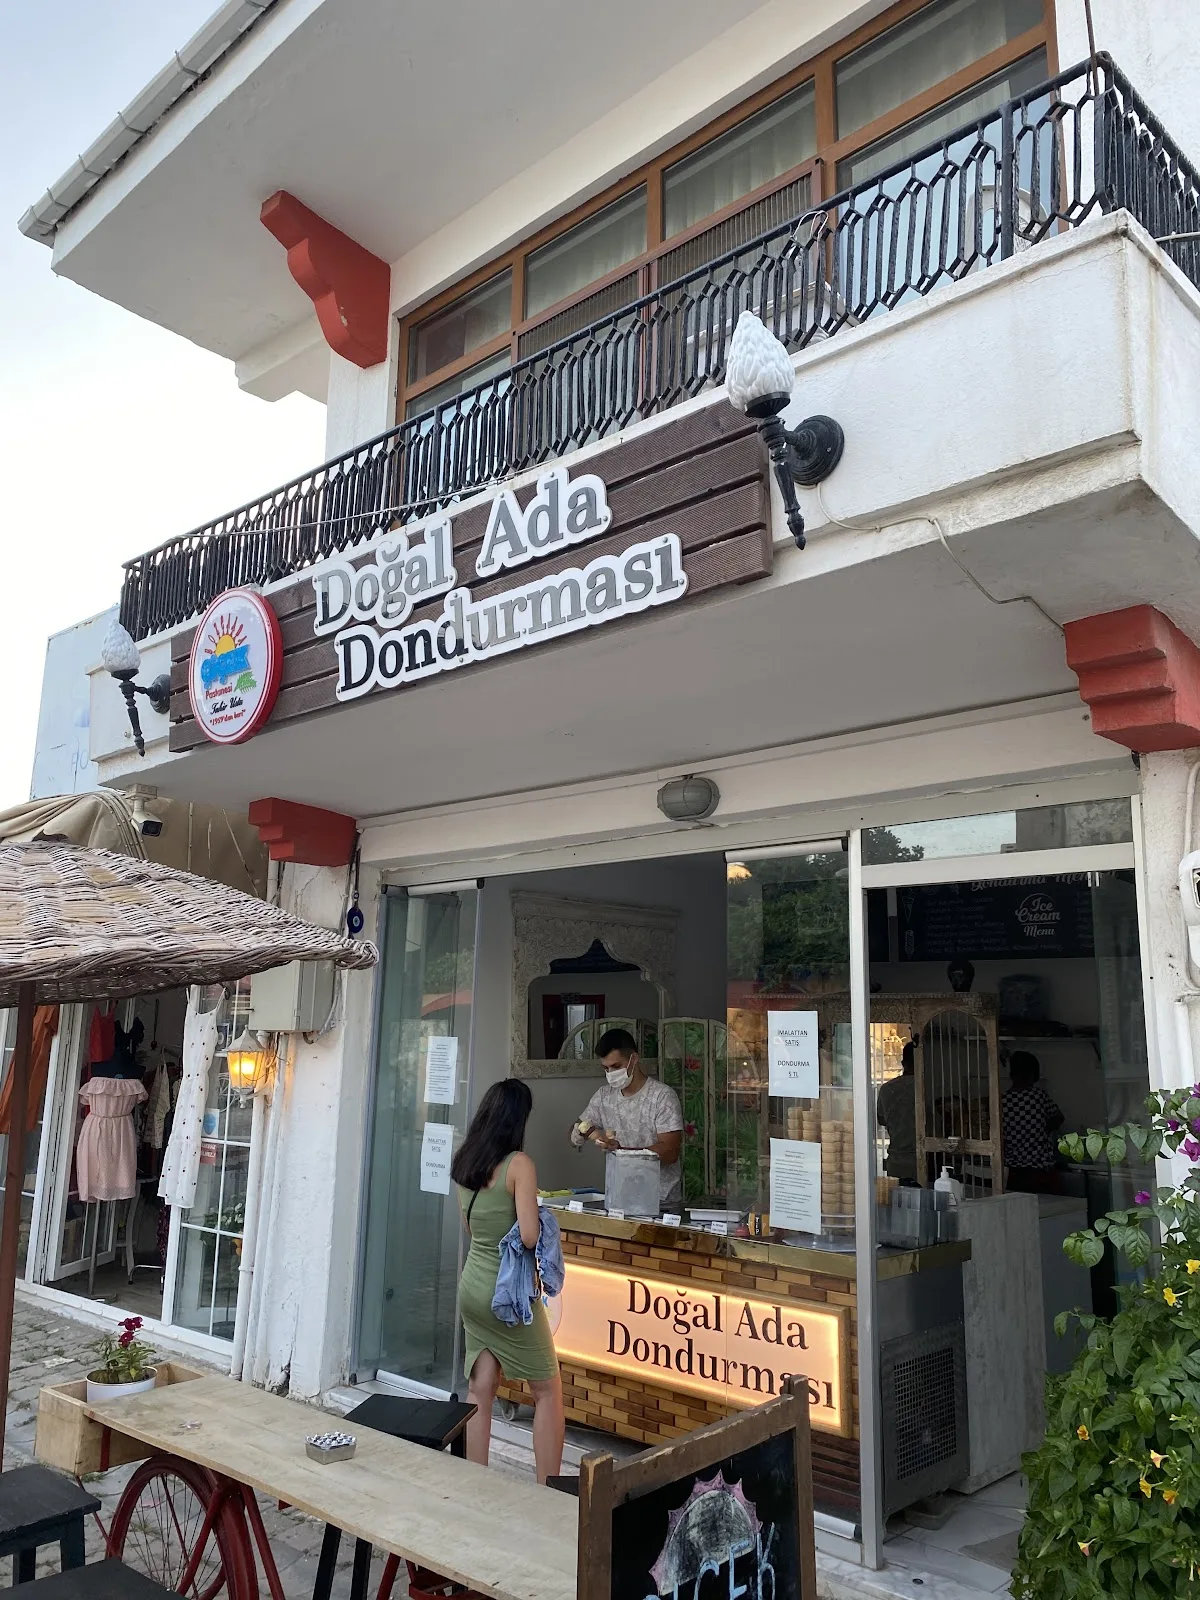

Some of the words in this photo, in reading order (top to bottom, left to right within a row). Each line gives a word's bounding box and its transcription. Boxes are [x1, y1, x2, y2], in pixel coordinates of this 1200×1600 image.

[317, 526, 449, 626] Doğal
[481, 476, 603, 569] Ada
[339, 543, 679, 693] Dondurması
[206, 682, 233, 700] Pastanesi
[1031, 897, 1053, 911] Ice
[1015, 907, 1061, 922] Cream
[1023, 925, 1055, 937] Menu
[627, 1279, 724, 1335] Doğal
[735, 1301, 810, 1350] Ada
